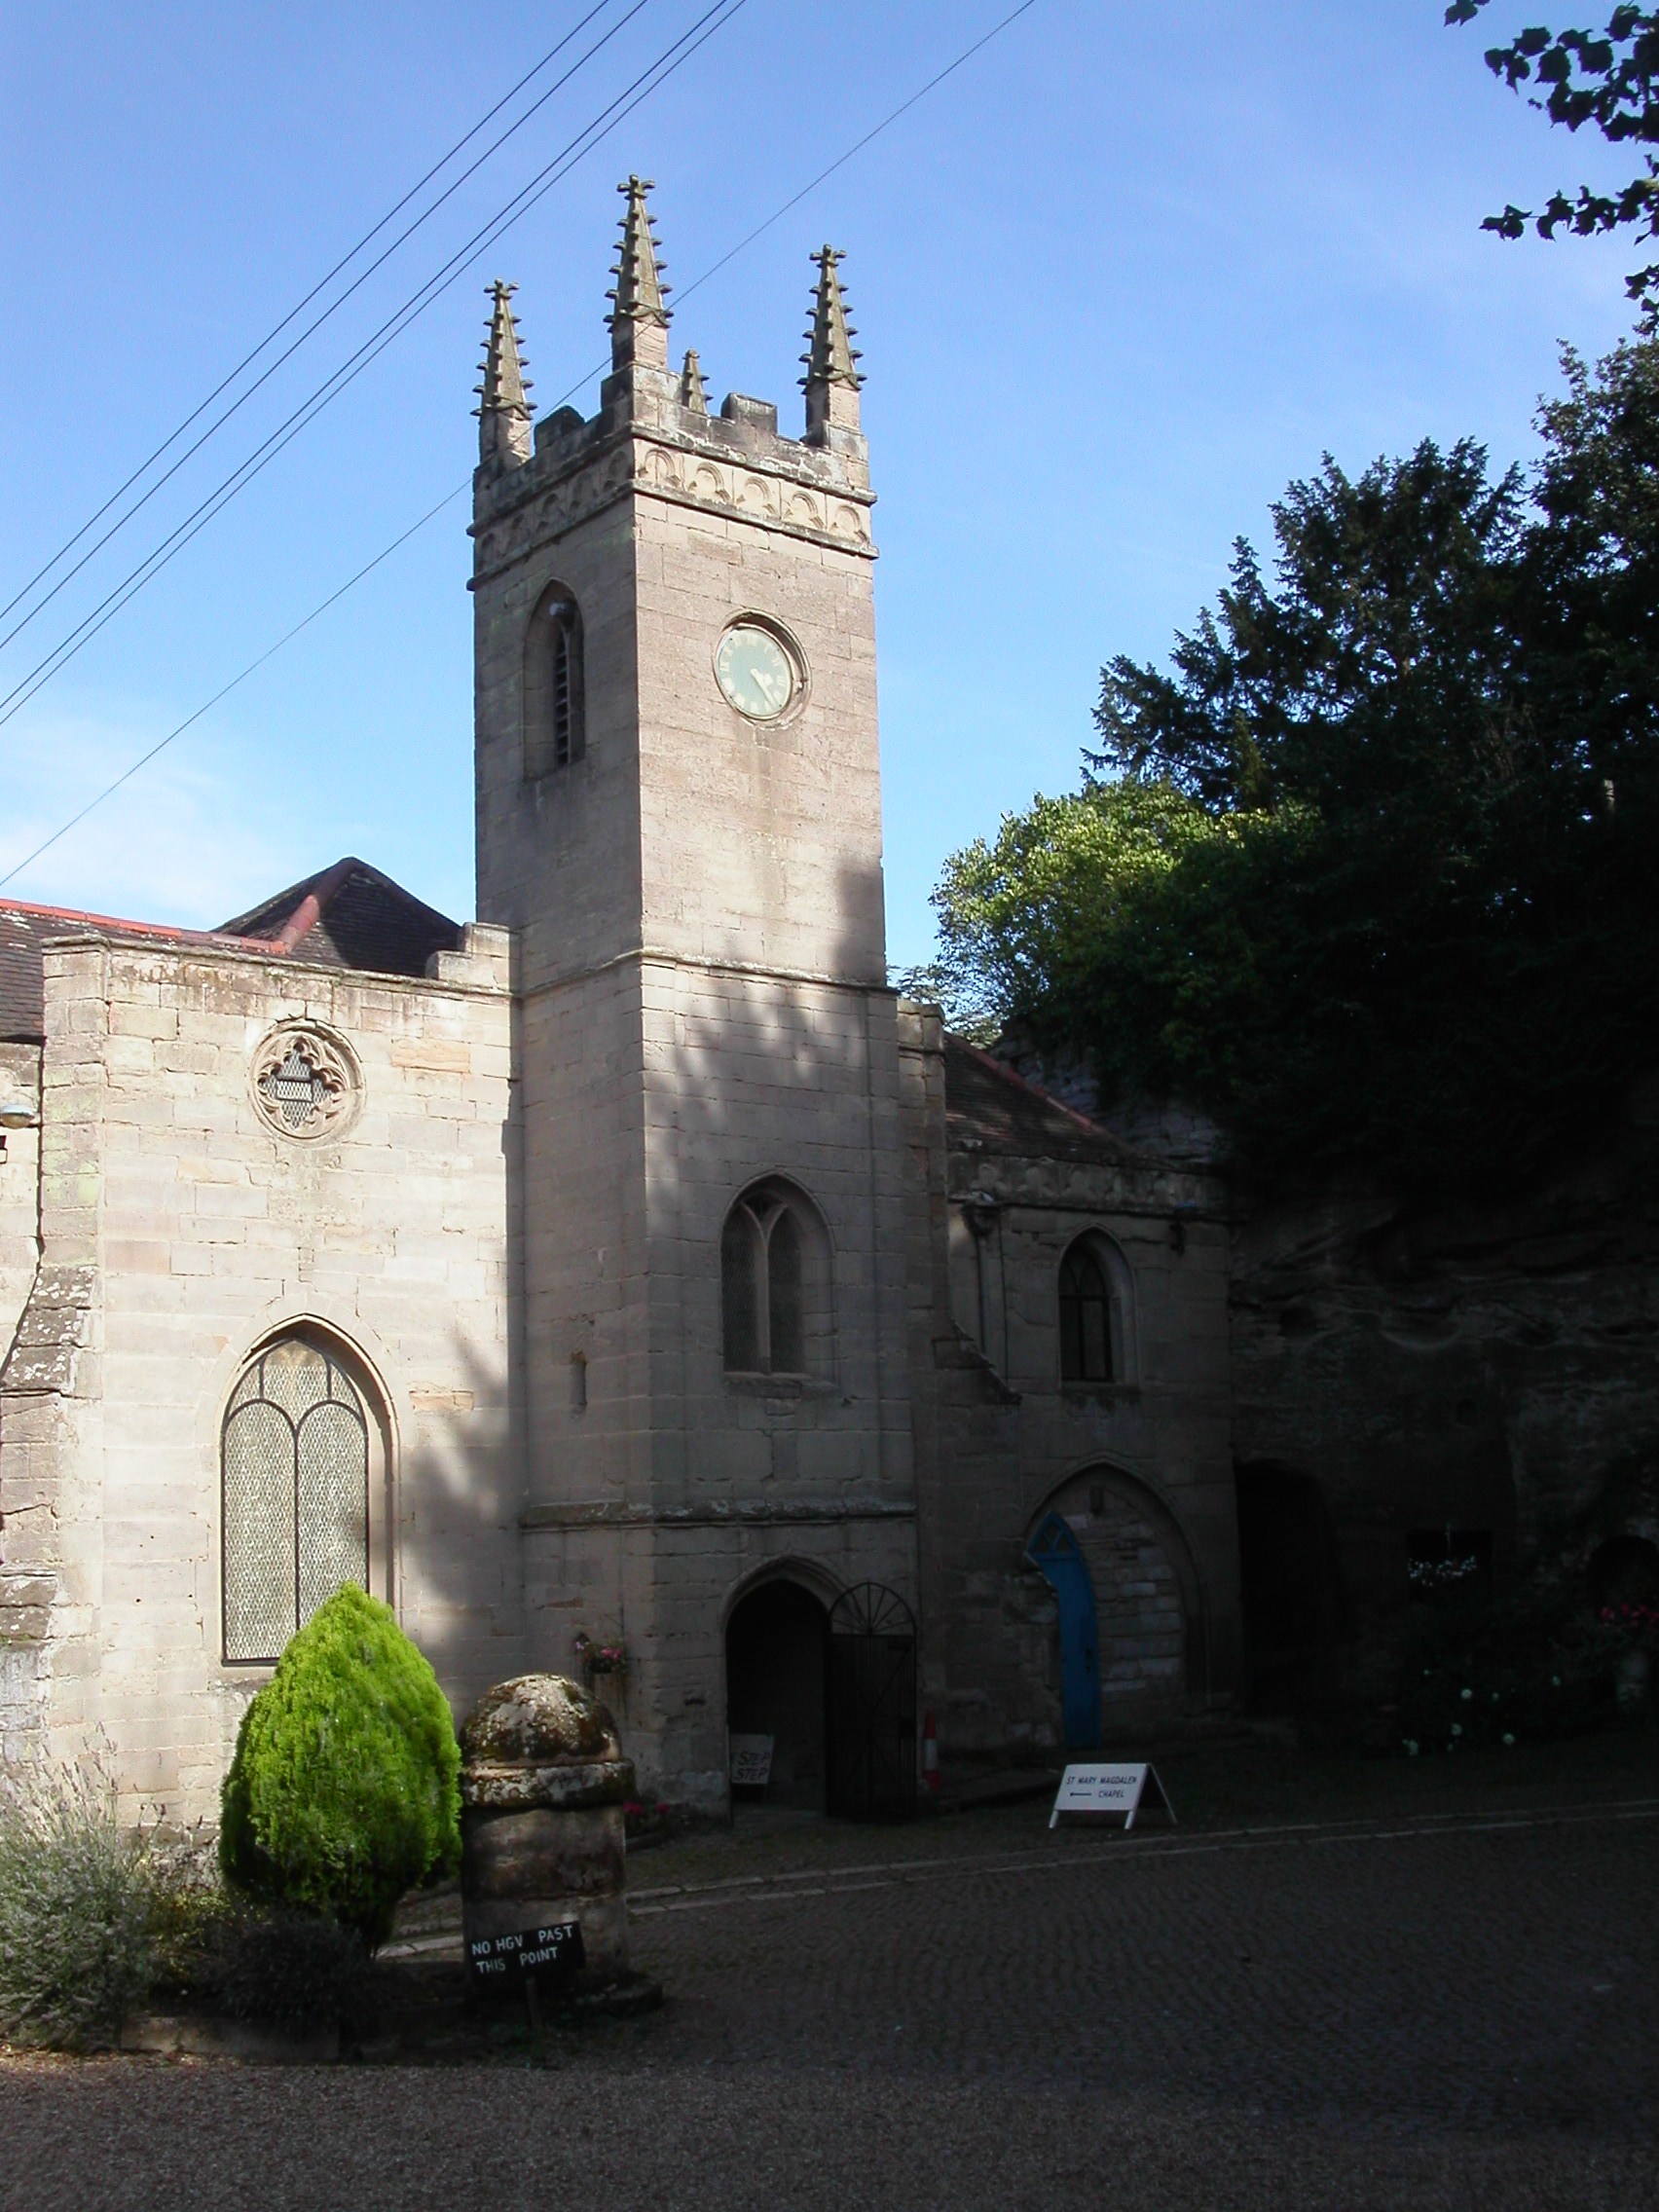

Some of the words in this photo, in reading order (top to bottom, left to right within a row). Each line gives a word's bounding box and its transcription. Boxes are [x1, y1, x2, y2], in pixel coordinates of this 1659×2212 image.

[737, 1750, 771, 1766] STEP
[734, 1766, 768, 1781] STEP
[1066, 1776, 1076, 1785] ST
[1078, 1776, 1097, 1785] MARY
[1099, 1776, 1138, 1785] MAGDALEN
[1098, 1789, 1124, 1798] CHAPEL
[471, 1941, 491, 1956] NO
[496, 1934, 523, 1952] HGV
[537, 1925, 572, 1943] PAST
[476, 1957, 506, 1973] THIS
[519, 1946, 558, 1967] POINT
